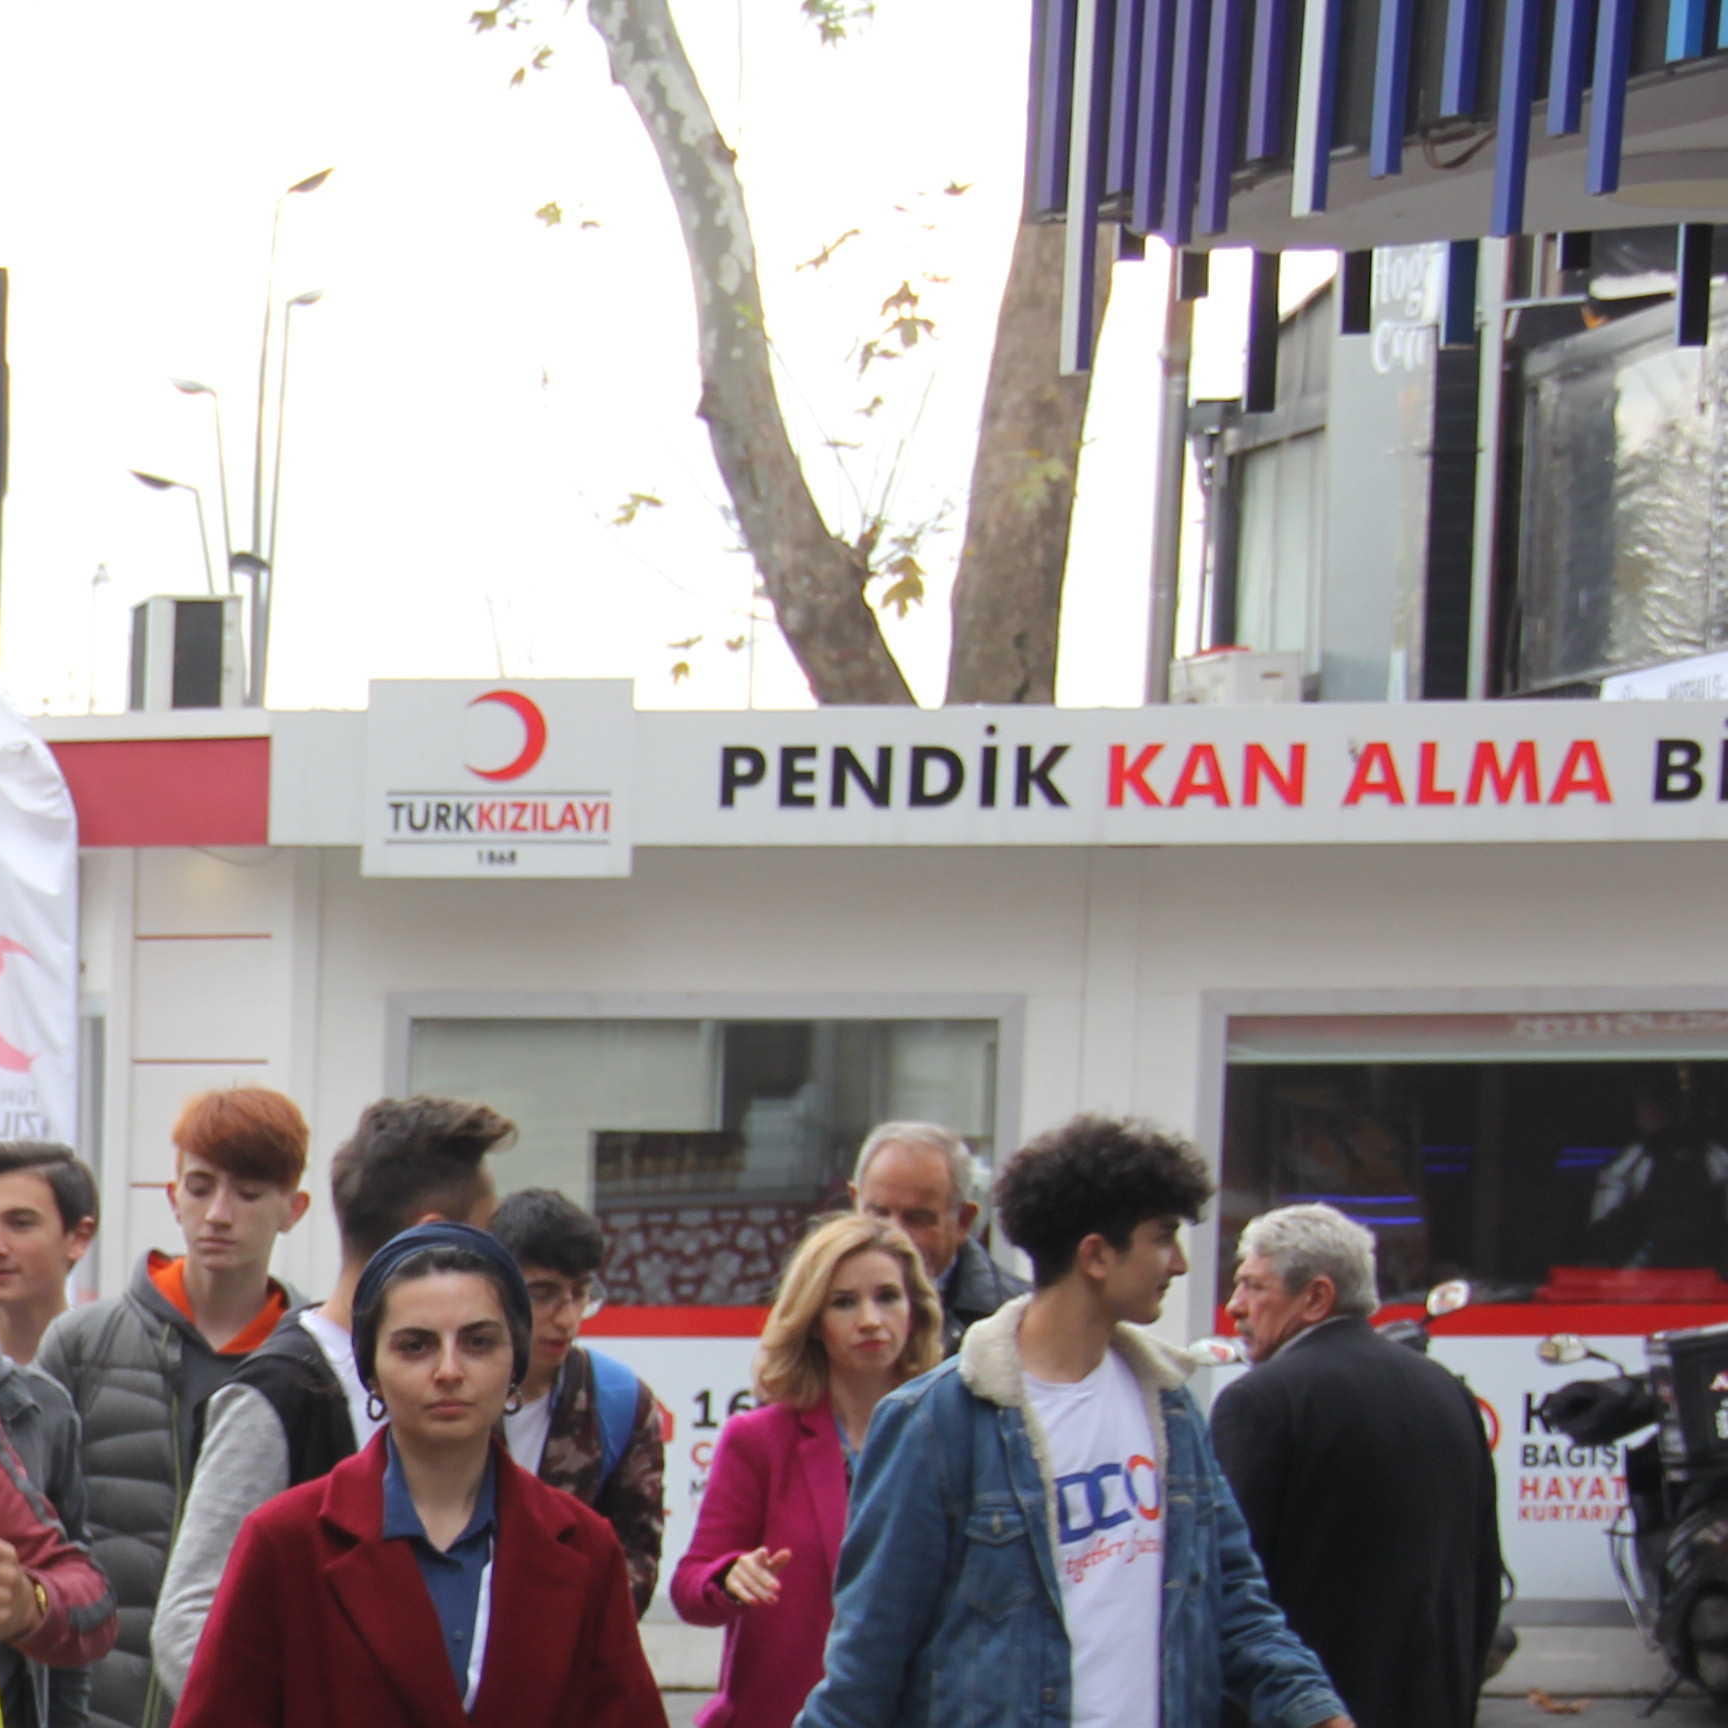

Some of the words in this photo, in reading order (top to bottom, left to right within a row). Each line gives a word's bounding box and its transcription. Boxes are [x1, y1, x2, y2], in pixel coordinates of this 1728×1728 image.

[720, 725, 1071, 807] PENDİK
[1106, 743, 1307, 806] KAN
[1342, 740, 1612, 804] ALMA
[1520, 1476, 1627, 1500] HAYAT
